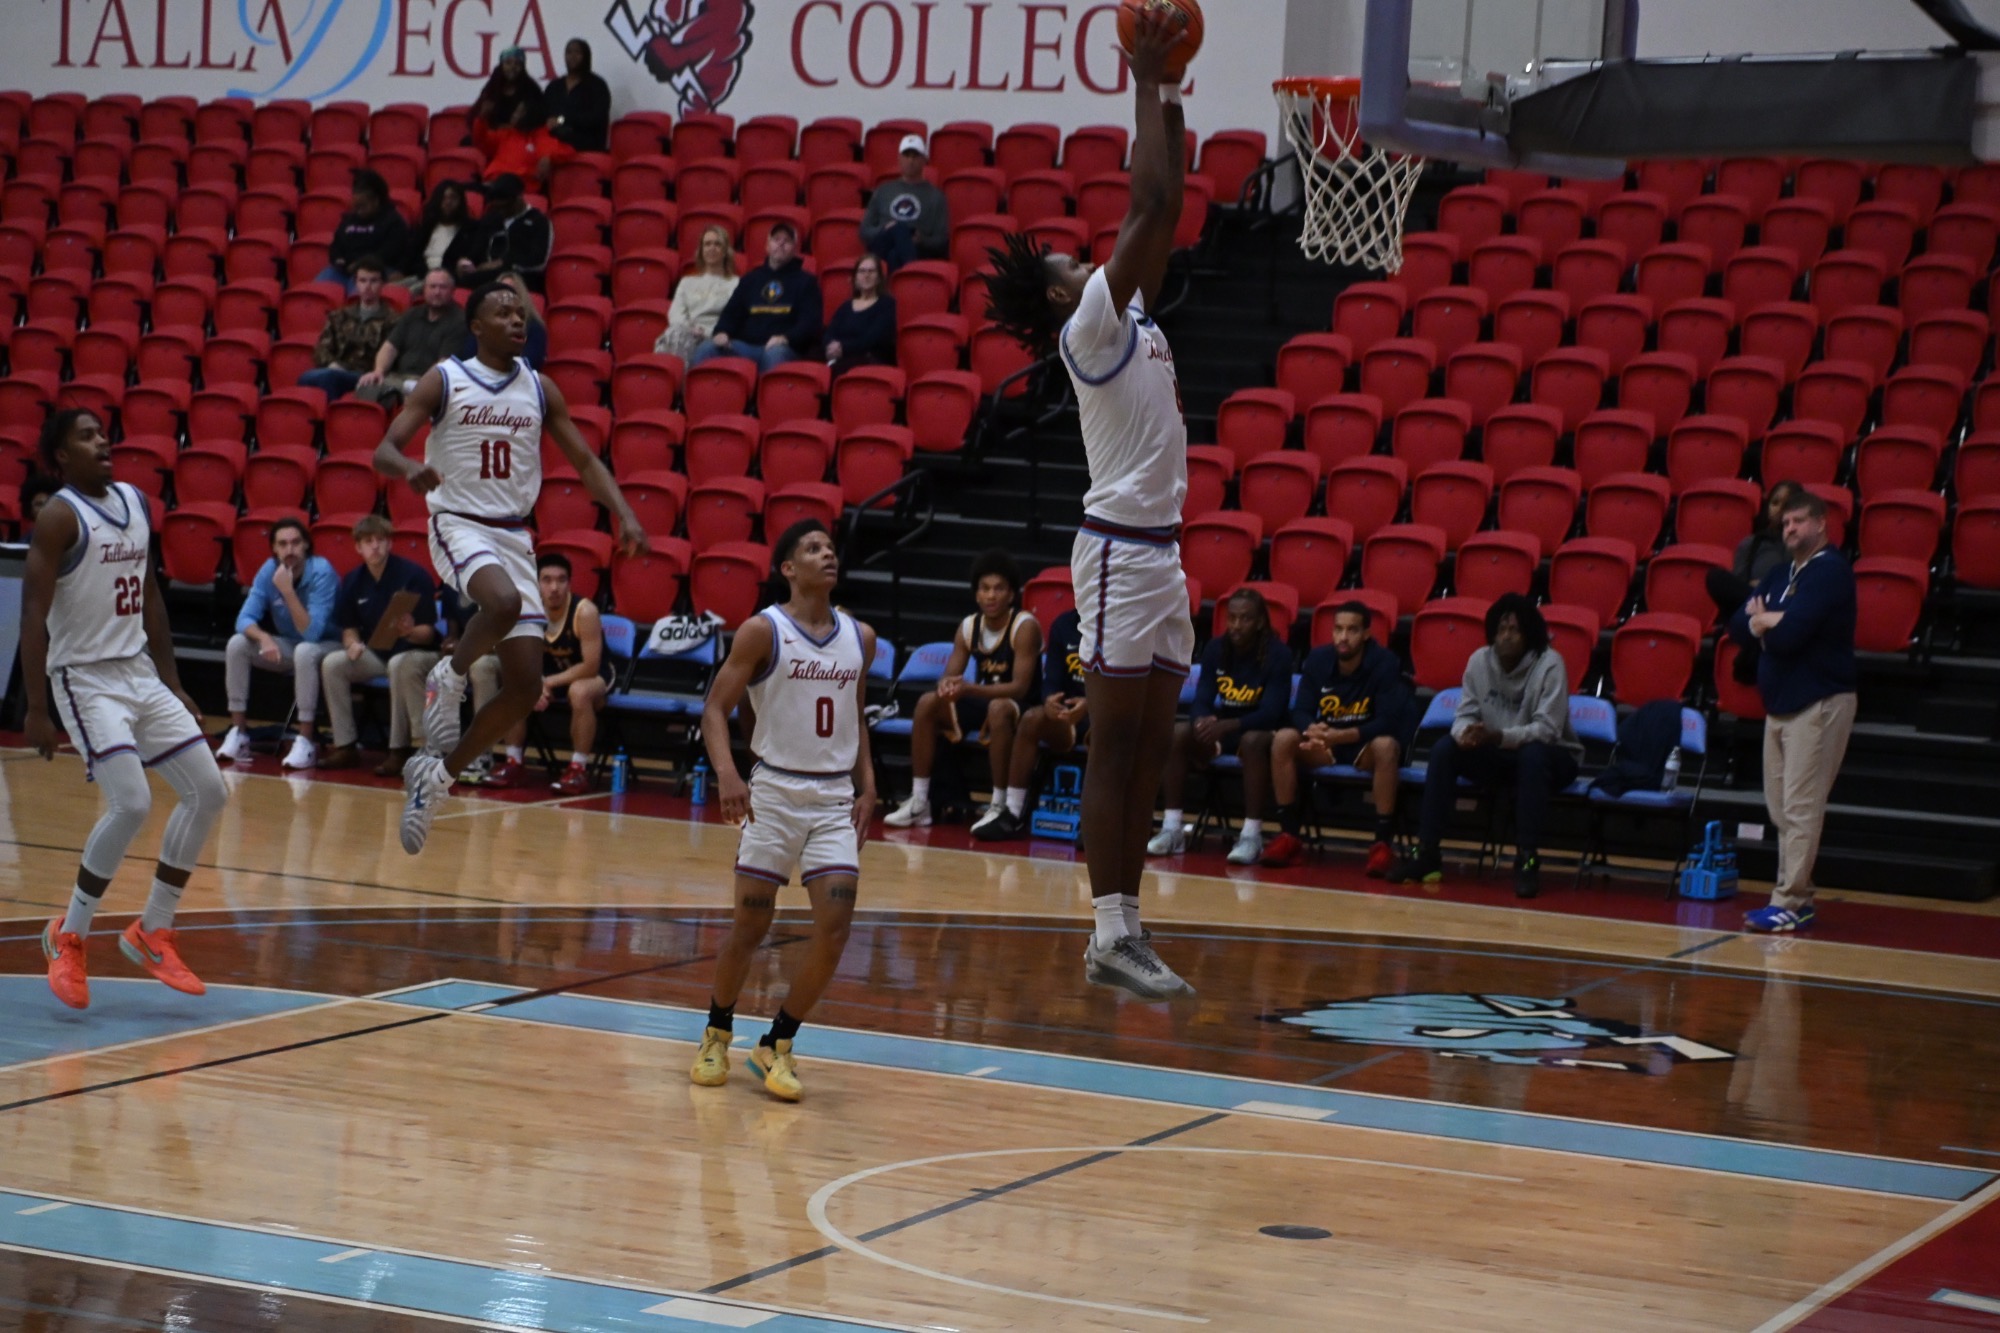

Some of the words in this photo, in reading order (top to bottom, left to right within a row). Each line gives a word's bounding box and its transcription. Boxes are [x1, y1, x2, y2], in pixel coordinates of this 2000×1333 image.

[791, 0, 1195, 96] COLLEG
[458, 405, 532, 436] Talladega
[480, 440, 511, 479] 10
[114, 575, 141, 616] 22
[788, 659, 858, 690] Talladega
[816, 696, 834, 737] 0
